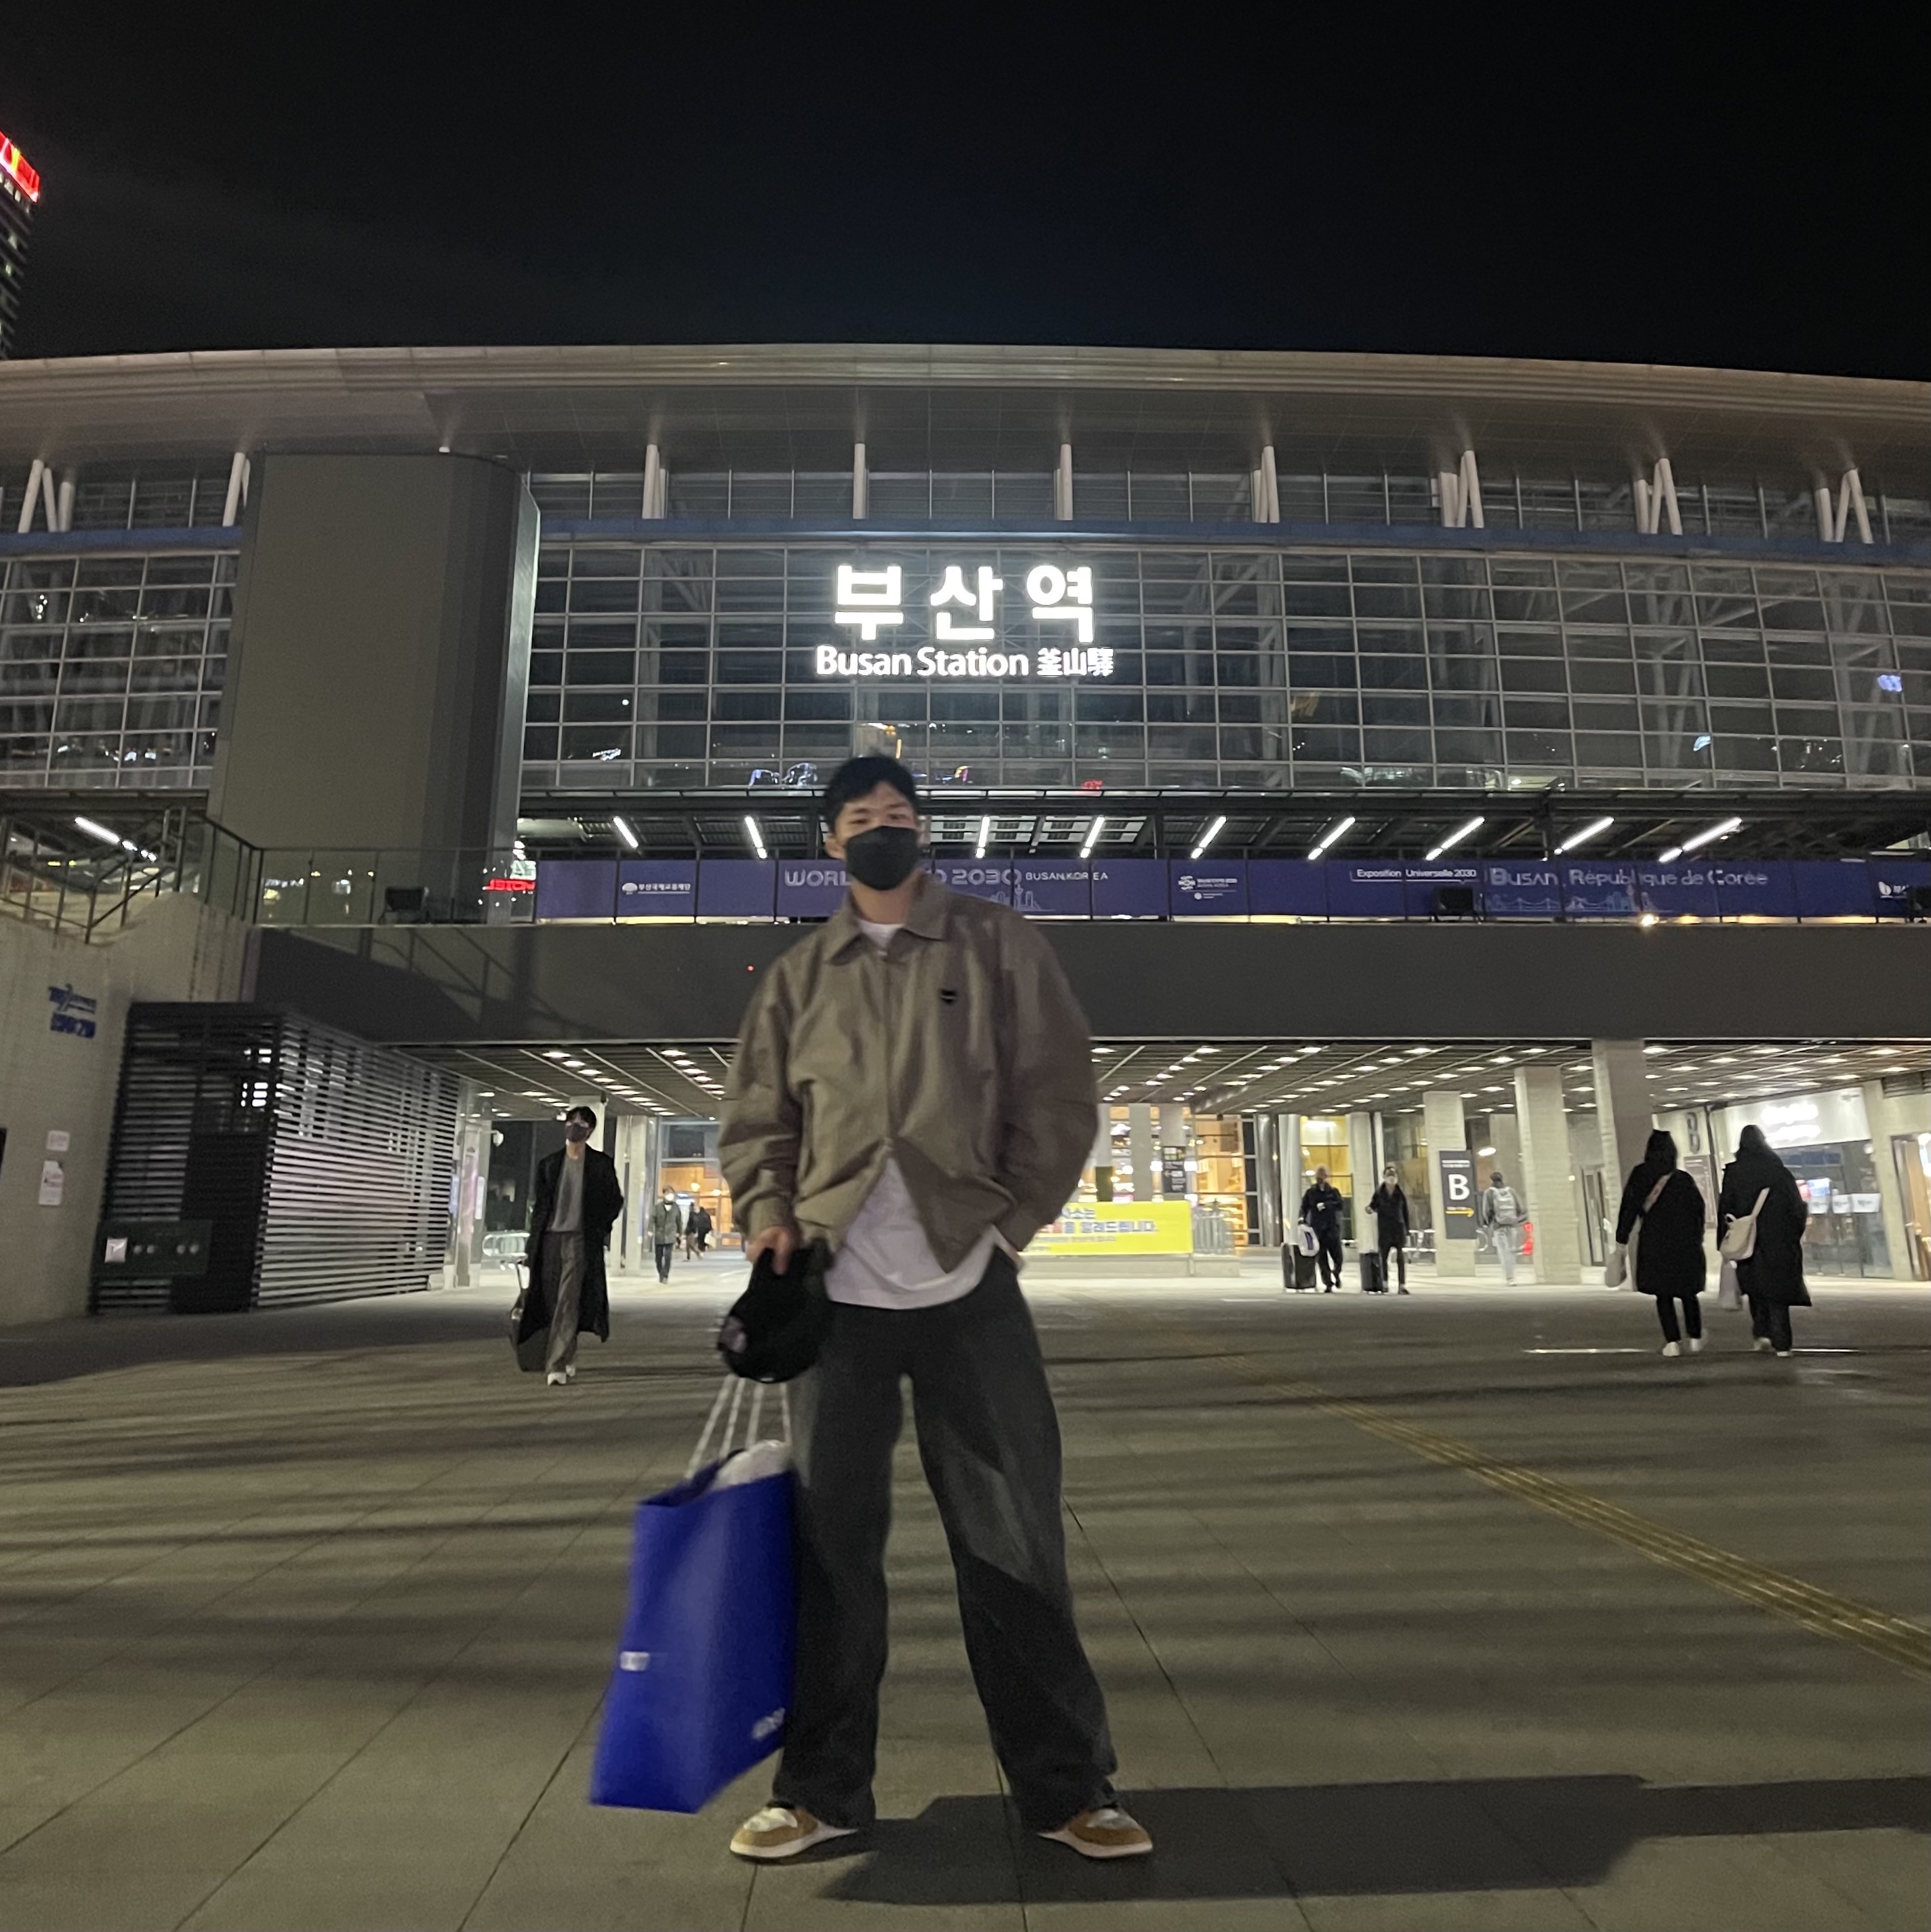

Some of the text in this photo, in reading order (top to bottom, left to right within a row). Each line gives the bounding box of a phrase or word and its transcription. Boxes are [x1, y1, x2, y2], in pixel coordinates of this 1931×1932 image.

[835, 564, 1094, 643] 부산역
[816, 645, 912, 676] Busan
[916, 647, 1030, 676] Station
[785, 869, 852, 887] WORL
[952, 868, 1022, 885] 2030
[1357, 869, 1402, 879] Exposition
[1454, 869, 1476, 877] 2030
[1681, 870, 1703, 885] de
[1448, 1173, 1470, 1200] B
